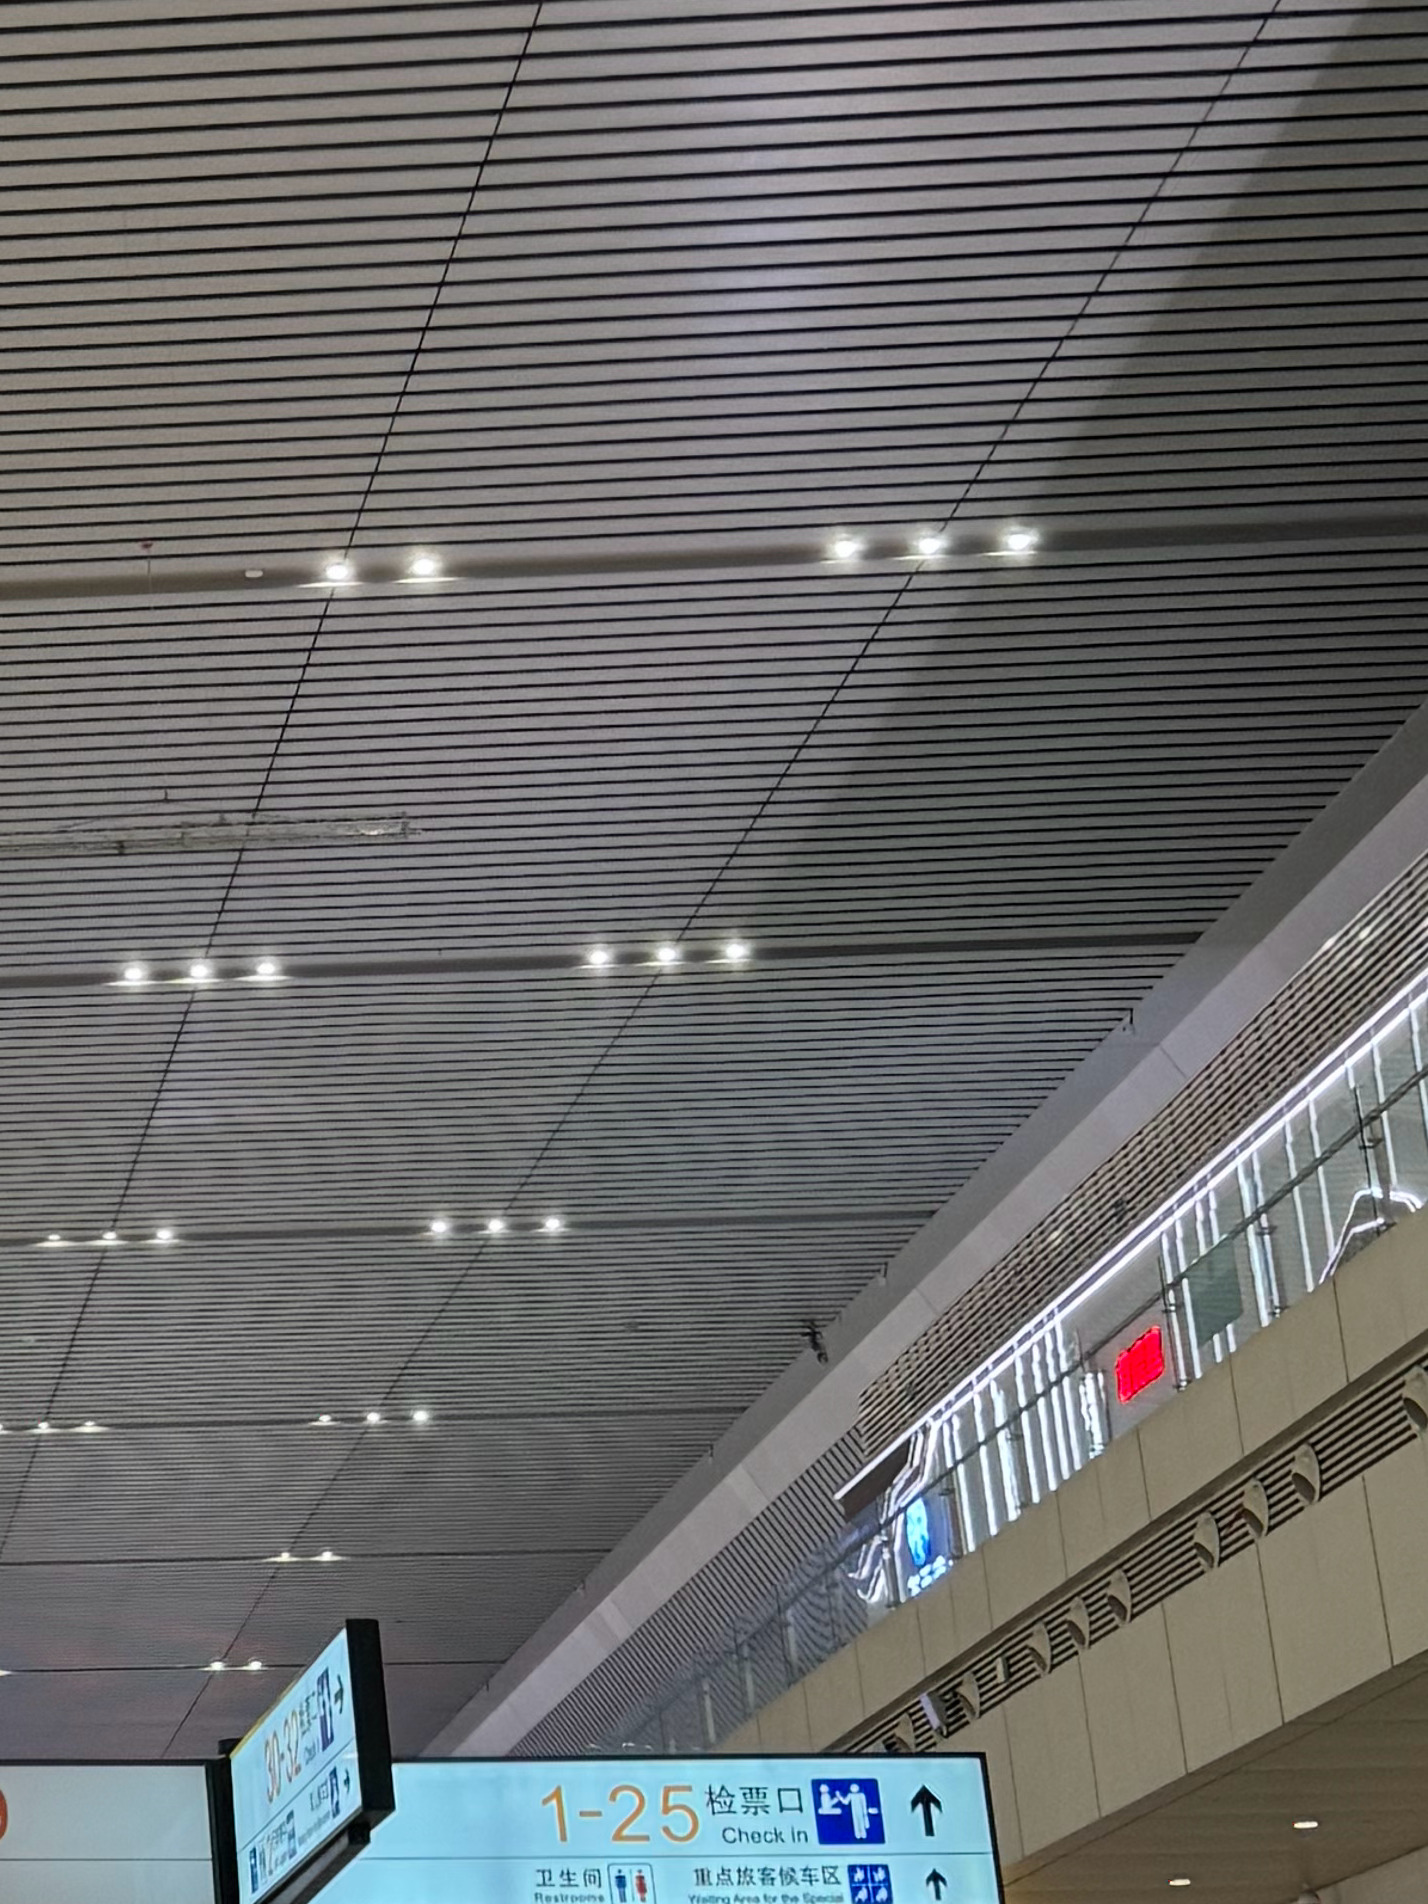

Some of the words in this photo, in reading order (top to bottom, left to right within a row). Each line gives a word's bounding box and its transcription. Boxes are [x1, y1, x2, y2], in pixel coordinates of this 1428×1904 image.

[705, 1784, 805, 1817] 检票口
[541, 1784, 700, 1843] 1-25
[721, 1826, 785, 1844] Check
[535, 1869, 603, 1889] 卫生间
[693, 1864, 842, 1887] 重点旅客候车区
